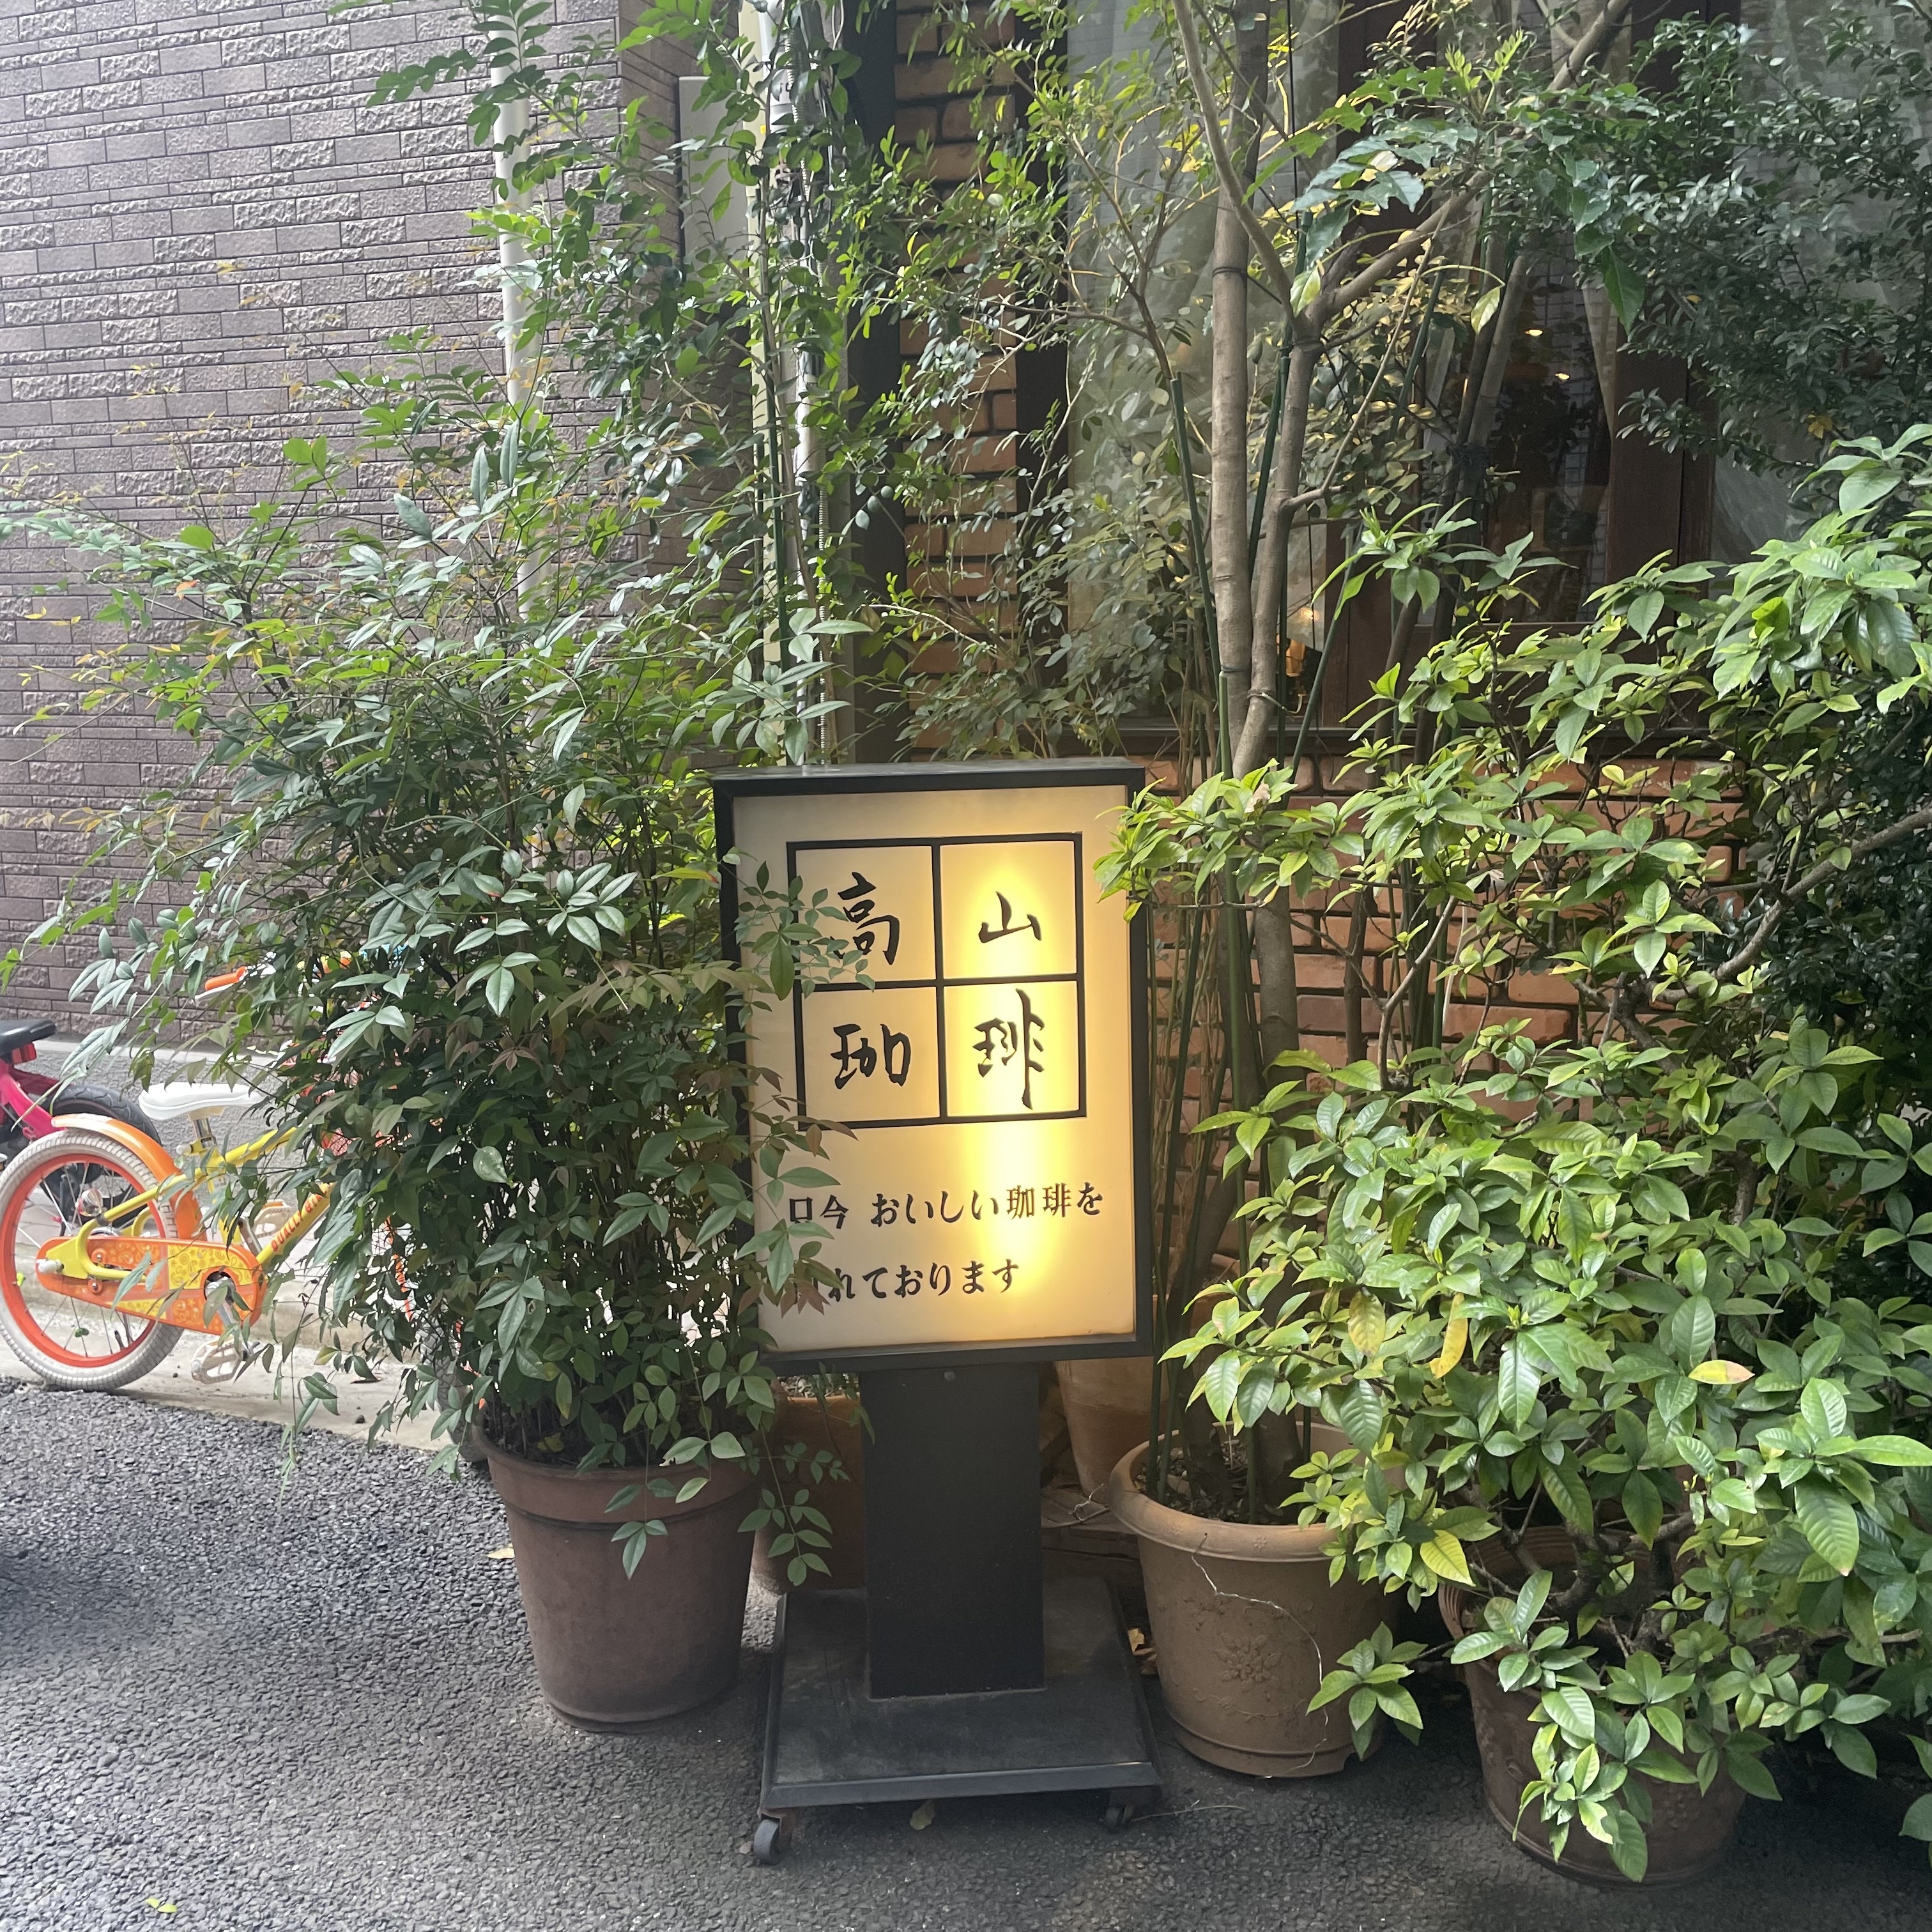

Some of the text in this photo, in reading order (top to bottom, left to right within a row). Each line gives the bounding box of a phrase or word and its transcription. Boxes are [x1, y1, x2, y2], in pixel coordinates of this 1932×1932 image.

[830, 871, 1041, 965] 高山
[830, 988, 1045, 1110] 珈琲
[870, 1182, 1103, 1227] おいしい珈琲を
[792, 1259, 1019, 1305] れております
